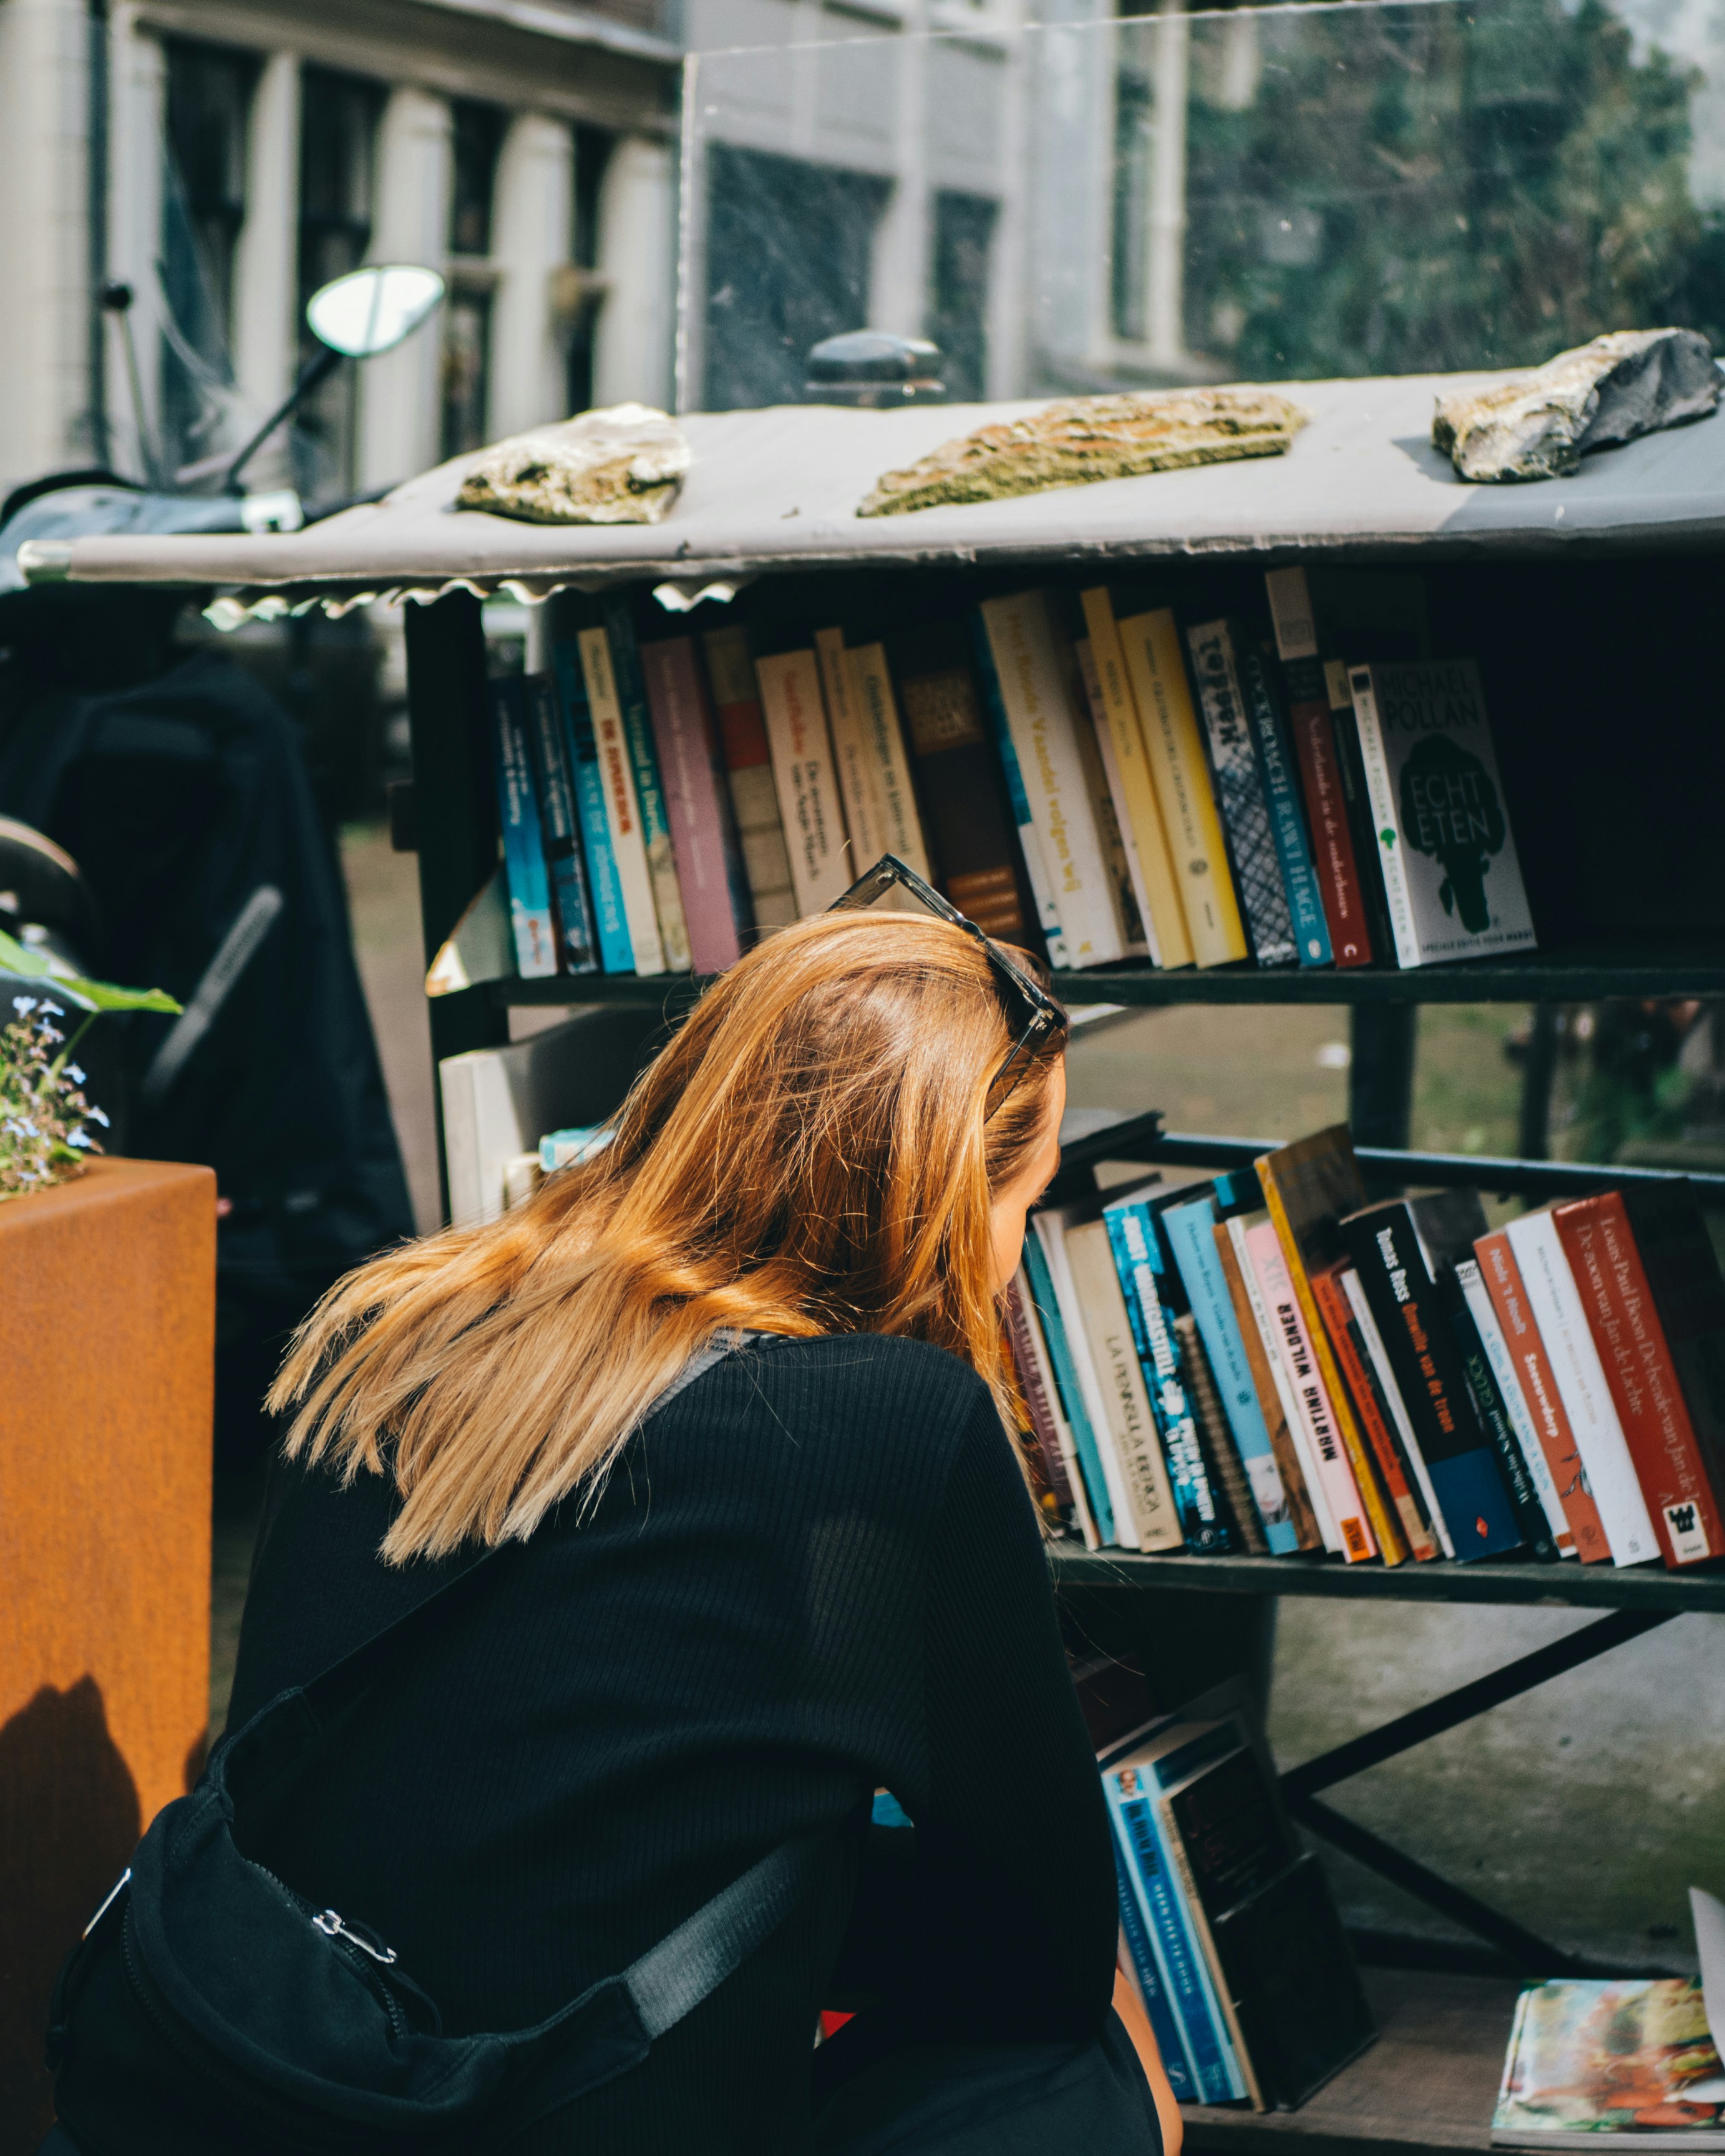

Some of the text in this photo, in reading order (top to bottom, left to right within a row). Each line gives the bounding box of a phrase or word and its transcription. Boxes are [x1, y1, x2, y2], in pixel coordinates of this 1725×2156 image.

[1381, 668, 1472, 697] MICHAEL
[1384, 697, 1479, 732] POLLAN
[1243, 653, 1318, 928] COCKROACH RAWI HAGE
[1411, 772, 1483, 810] ECHT
[1043, 797, 1074, 861] volgen
[1358, 696, 1409, 933] MICHAEL POLLAN ECHT ETEN
[1419, 809, 1490, 848] ETEN
[1058, 862, 1082, 893] wij
[1597, 1216, 1627, 1263] Louis
[1195, 1254, 1207, 1270] van
[1374, 1226, 1414, 1303] Tomas Ross
[1611, 1260, 1636, 1296] Paul
[1488, 1248, 1510, 1284] Niels
[1504, 1296, 1527, 1336] Hooft
[1400, 1301, 1432, 1353] Omwille
[1575, 1223, 1650, 1417] De zoon van Jan de Lichte
[1621, 1296, 1650, 1339] Boon
[1104, 1335, 1124, 1359] LA
[1219, 1331, 1230, 1348] van
[1636, 1339, 1658, 1365] De
[1275, 1301, 1338, 1462] MARTINA WILDNER
[1418, 1354, 1437, 1378] van
[1426, 1377, 1446, 1397] de
[1522, 1351, 1562, 1439] Sneeuwdorp
[1643, 1365, 1673, 1414] bende
[1432, 1396, 1457, 1434] troon
[1658, 1415, 1677, 1445] van
[1533, 1460, 1553, 1492] GUN
[1663, 1440, 1693, 1474] Jan
[1676, 1470, 1699, 1493] de
